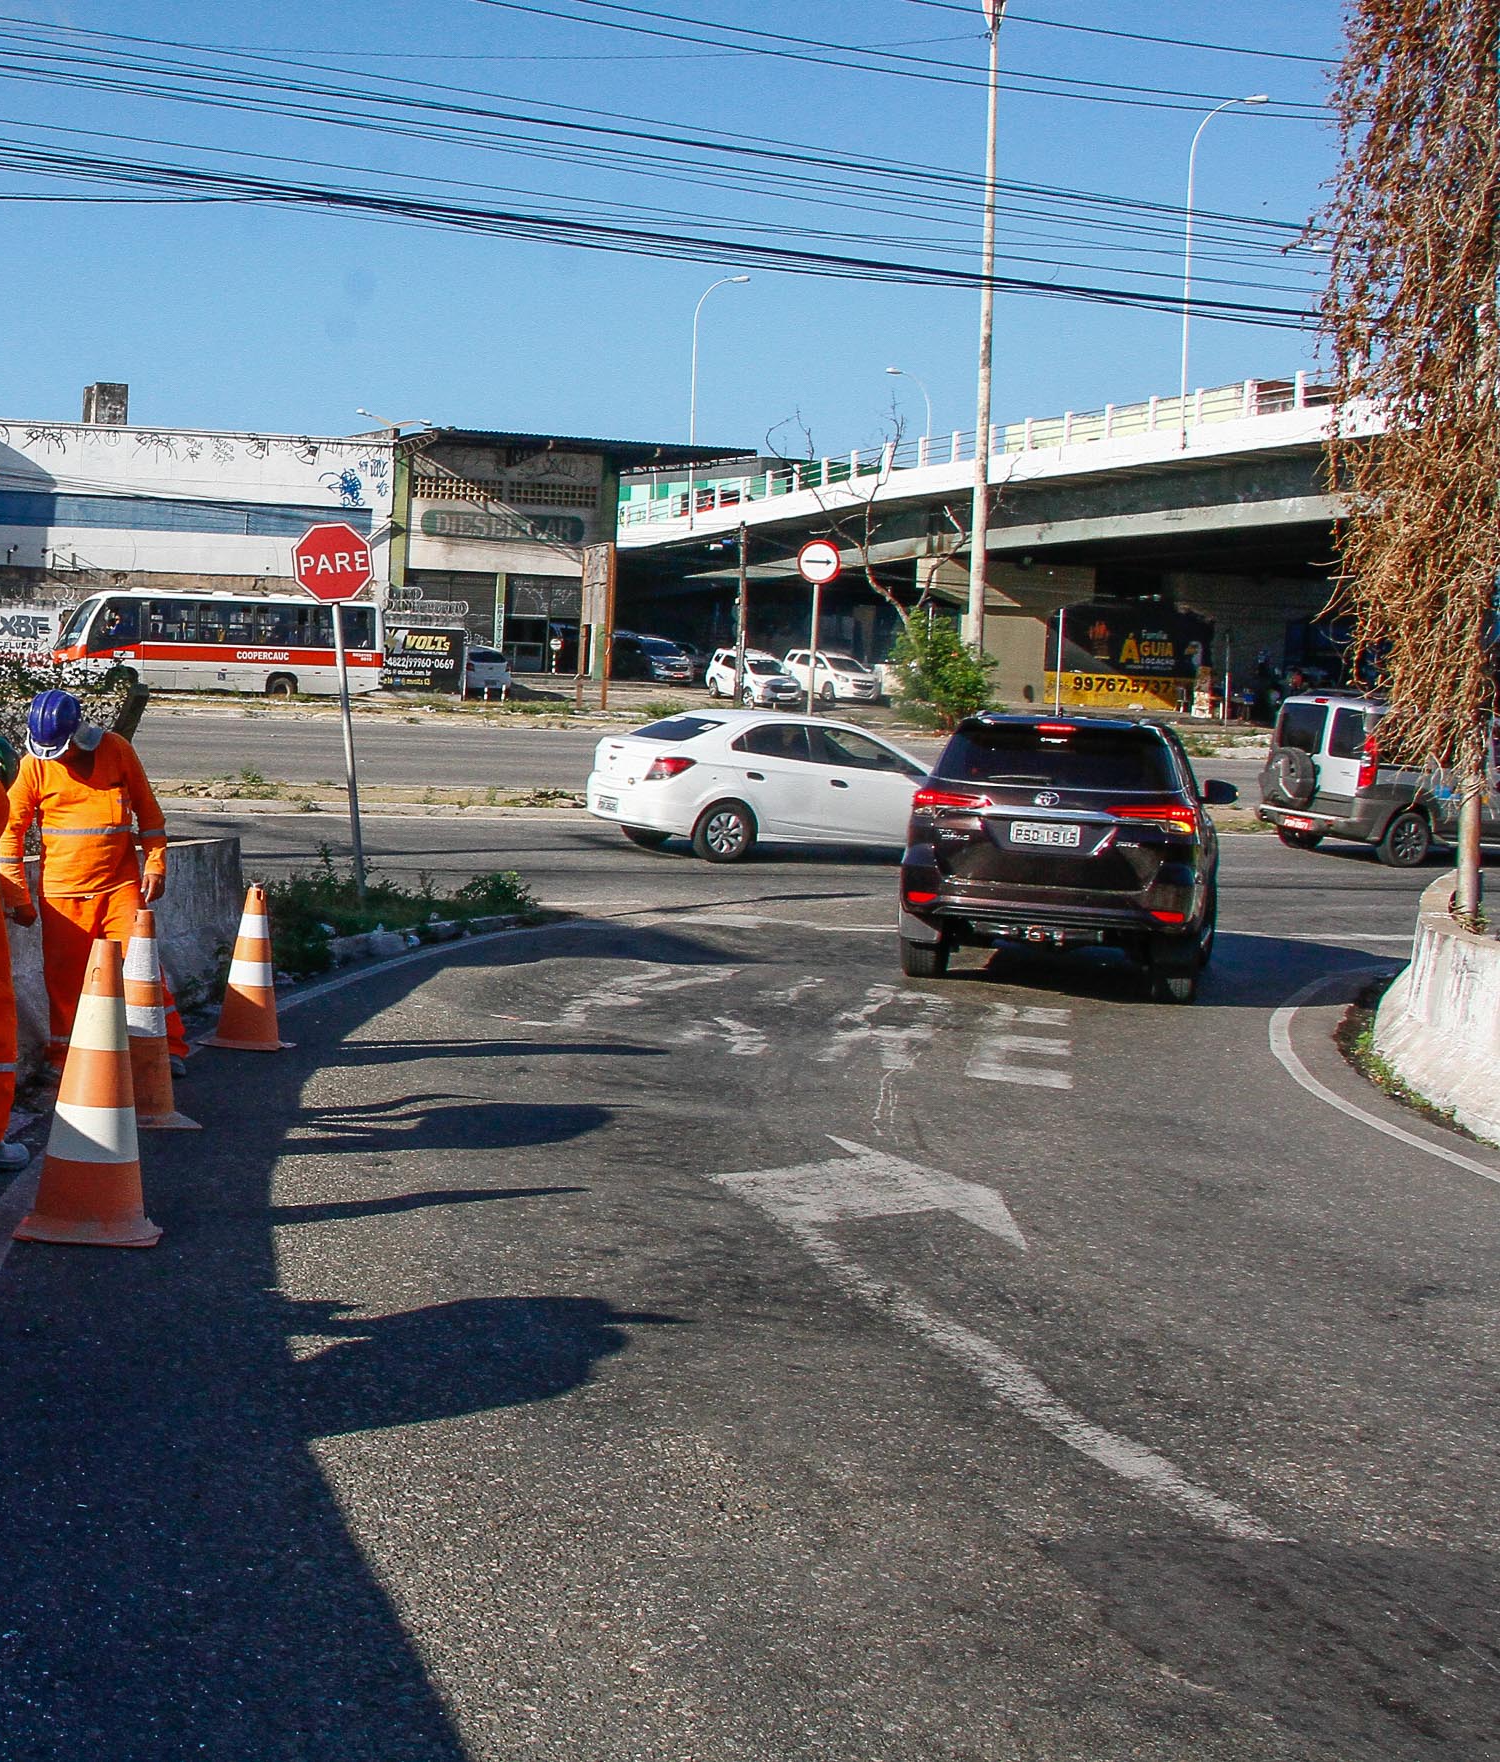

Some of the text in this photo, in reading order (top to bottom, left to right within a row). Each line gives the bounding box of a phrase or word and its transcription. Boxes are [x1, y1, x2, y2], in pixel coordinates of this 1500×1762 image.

[299, 550, 369, 576] PARE
[236, 651, 290, 661] COOPERCAUC
[1119, 632, 1174, 663] ÁGUIA
[1073, 676, 1172, 694] 99767.5737
